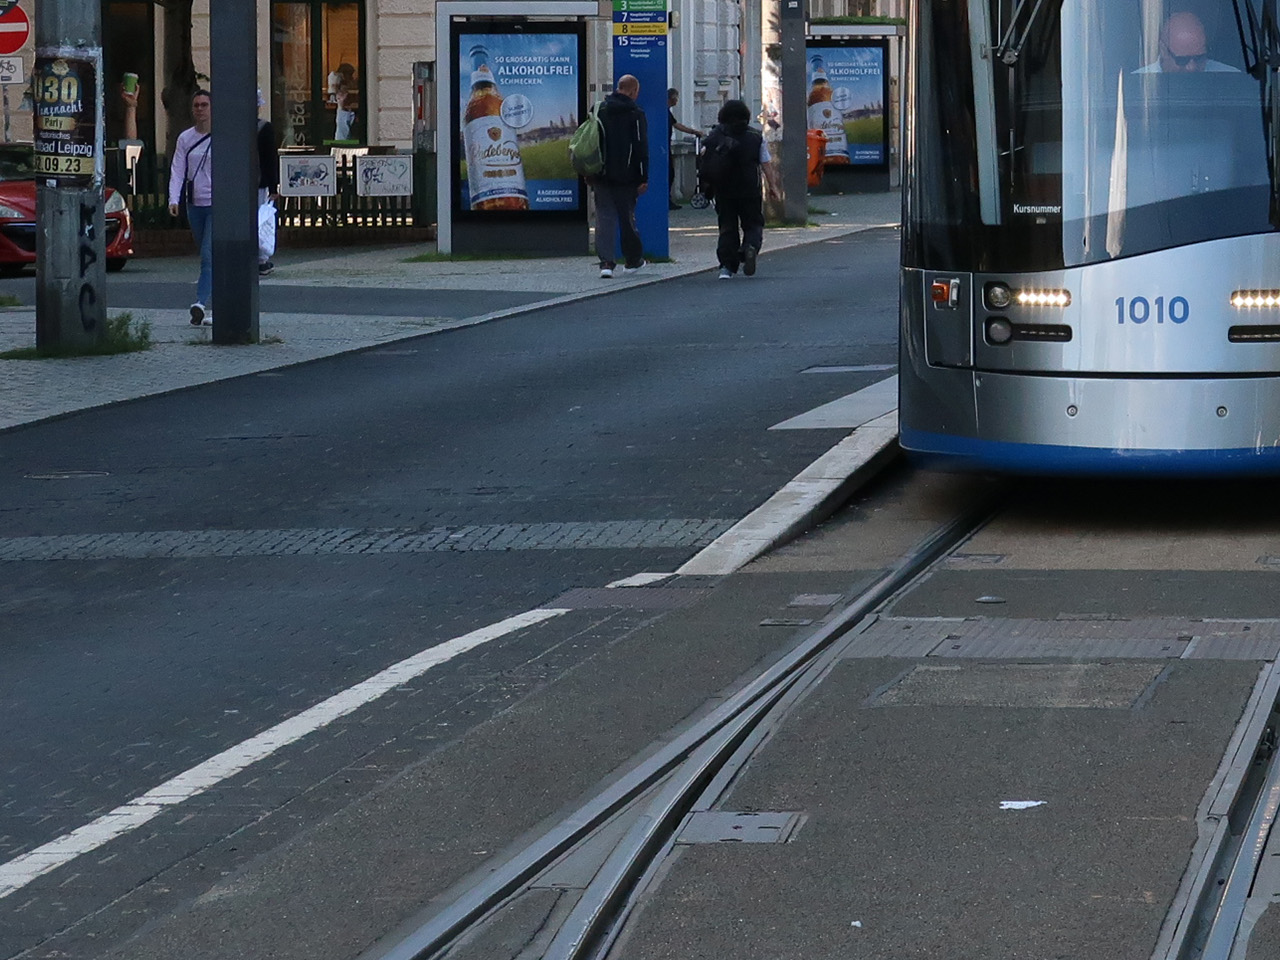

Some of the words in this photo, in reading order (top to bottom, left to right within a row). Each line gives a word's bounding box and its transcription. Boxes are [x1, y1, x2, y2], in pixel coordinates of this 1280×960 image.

[621, 0, 628, 11] 3
[621, 12, 628, 22] 7
[621, 23, 629, 34] 8
[617, 35, 629, 46] 15
[494, 56, 505, 64] SO
[506, 56, 549, 64] GROSSARTIG
[498, 65, 573, 76] ALKOHOLFREI
[44, 117, 63, 129] Party
[57, 141, 92, 157] Leipzig
[1013, 203, 1062, 214] Kursnummer
[1115, 295, 1190, 325] 1010
